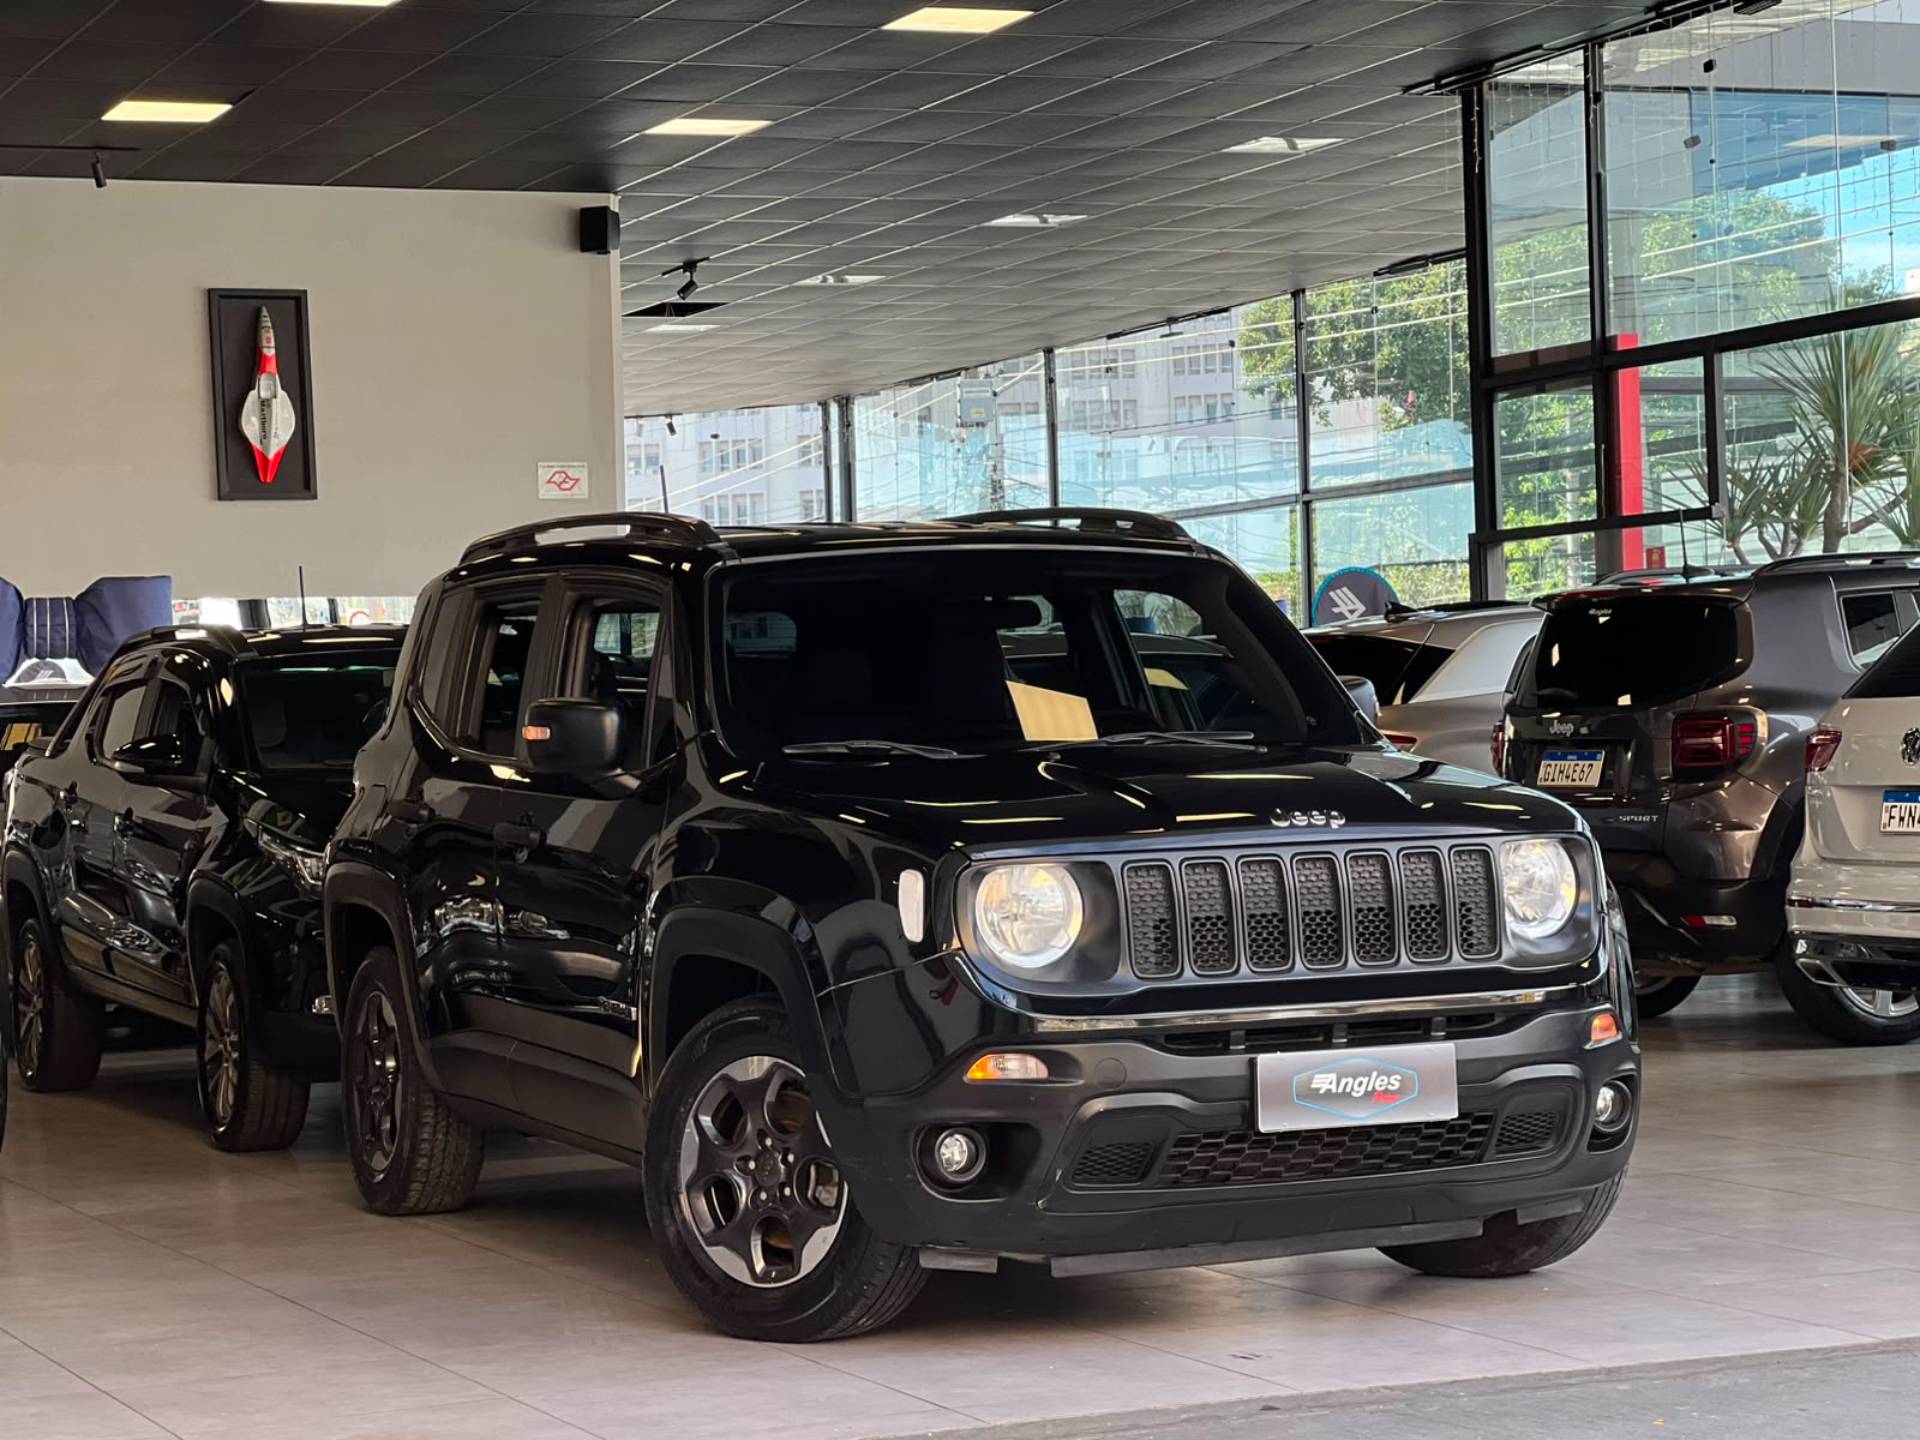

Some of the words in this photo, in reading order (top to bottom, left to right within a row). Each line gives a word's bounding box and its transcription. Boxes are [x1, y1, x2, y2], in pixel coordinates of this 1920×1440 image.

[1549, 719, 1574, 737] Jeep
[1543, 763, 1594, 783] GIH4E67
[1270, 807, 1346, 829] Jeep
[1888, 804, 1920, 829] FWN
[1310, 1071, 1402, 1097] Angles
